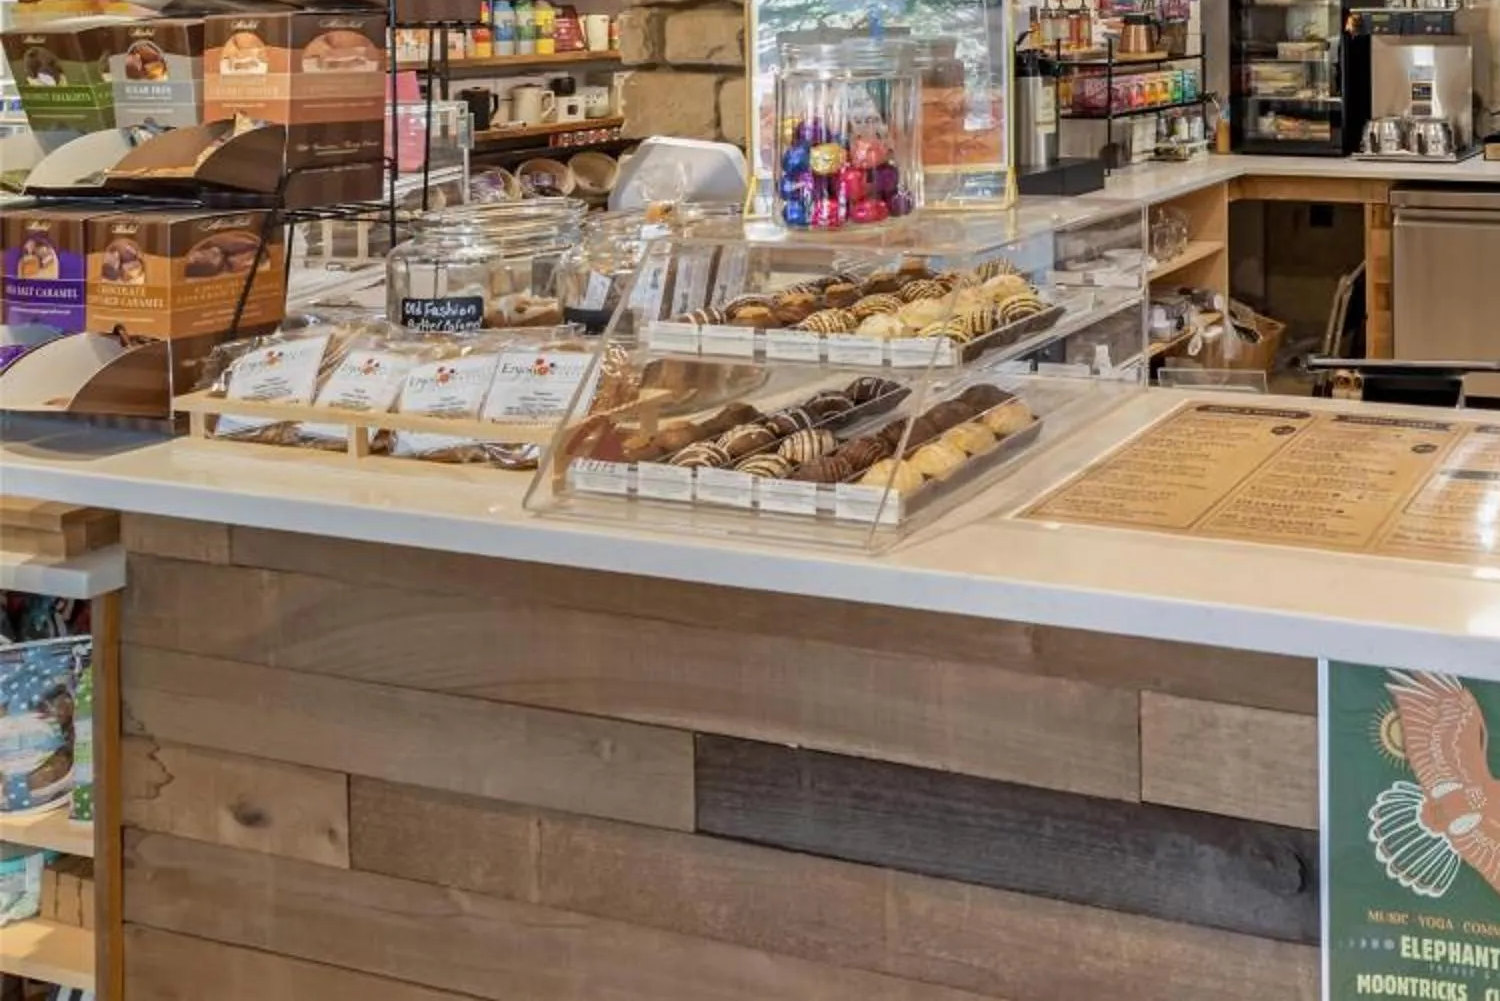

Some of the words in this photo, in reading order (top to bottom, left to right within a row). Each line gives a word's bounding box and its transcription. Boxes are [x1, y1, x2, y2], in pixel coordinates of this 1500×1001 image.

[405, 301, 423, 316] Old
[424, 300, 477, 318] Fashion
[1368, 910, 1409, 925] MUSIC
[1419, 915, 1453, 930] YOGA
[1400, 935, 1500, 972] ELEPHANT
[1356, 974, 1468, 1001] MOONTRICKS
